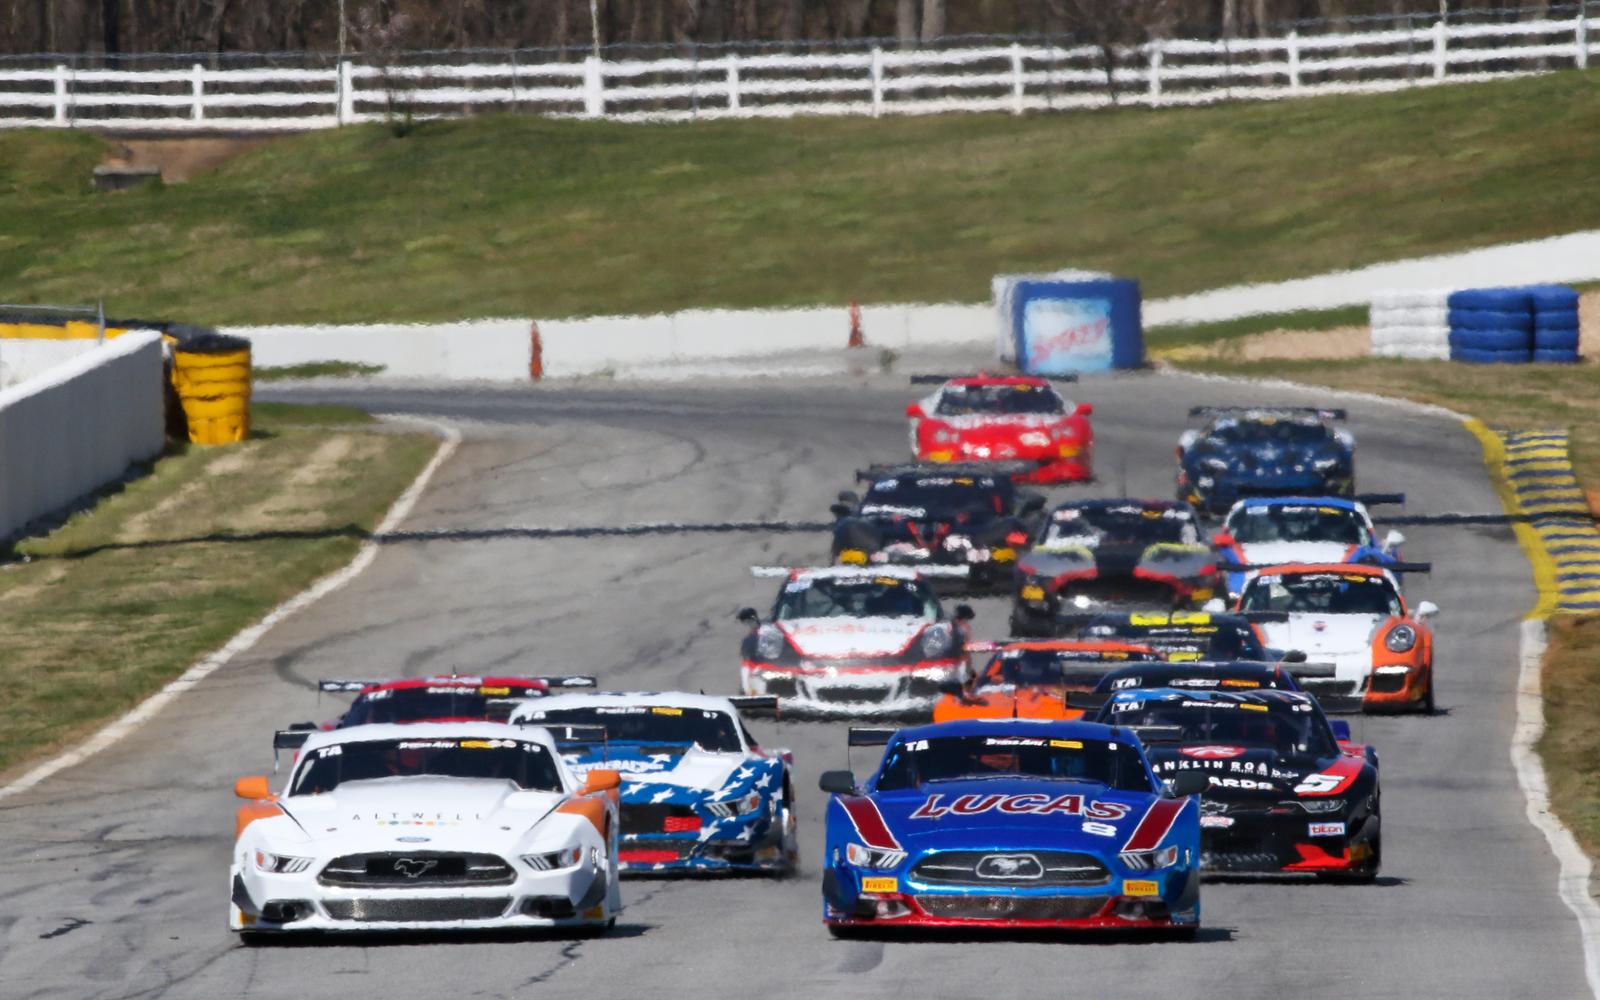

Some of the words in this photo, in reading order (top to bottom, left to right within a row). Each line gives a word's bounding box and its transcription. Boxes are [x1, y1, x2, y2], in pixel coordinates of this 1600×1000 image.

[1116, 700, 1141, 712] TA
[317, 744, 343, 758] TA
[905, 740, 930, 751] TA
[1108, 743, 1118, 751] 8
[1152, 760, 1224, 773] ANKLIN
[1293, 773, 1346, 793] 5
[909, 794, 1132, 820] LUCAS
[1082, 821, 1117, 837] 8
